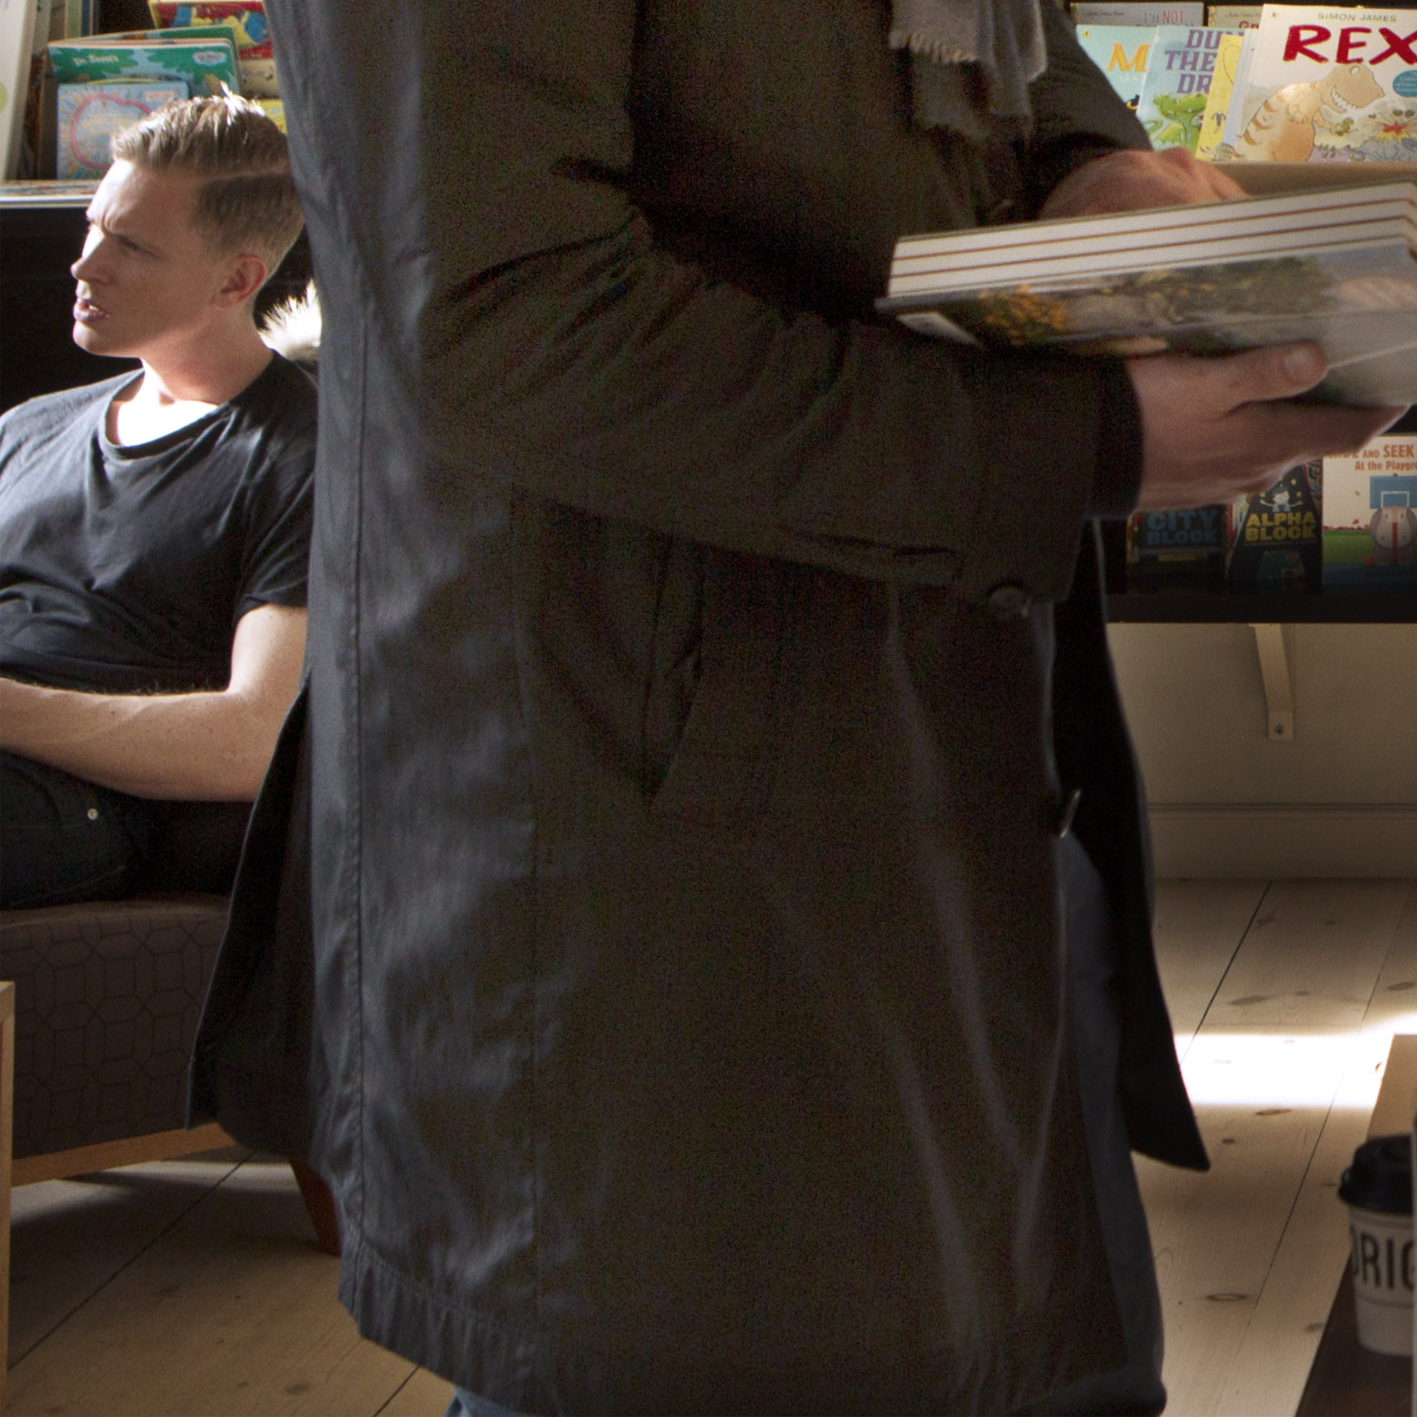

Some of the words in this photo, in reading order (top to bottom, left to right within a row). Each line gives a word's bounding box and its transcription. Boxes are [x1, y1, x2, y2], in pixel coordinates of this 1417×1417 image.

[1165, 50, 1215, 71] THE
[1383, 445, 1414, 458] SEEK
[1247, 513, 1317, 527] ALPHA
[1245, 526, 1317, 542] BLOCK
